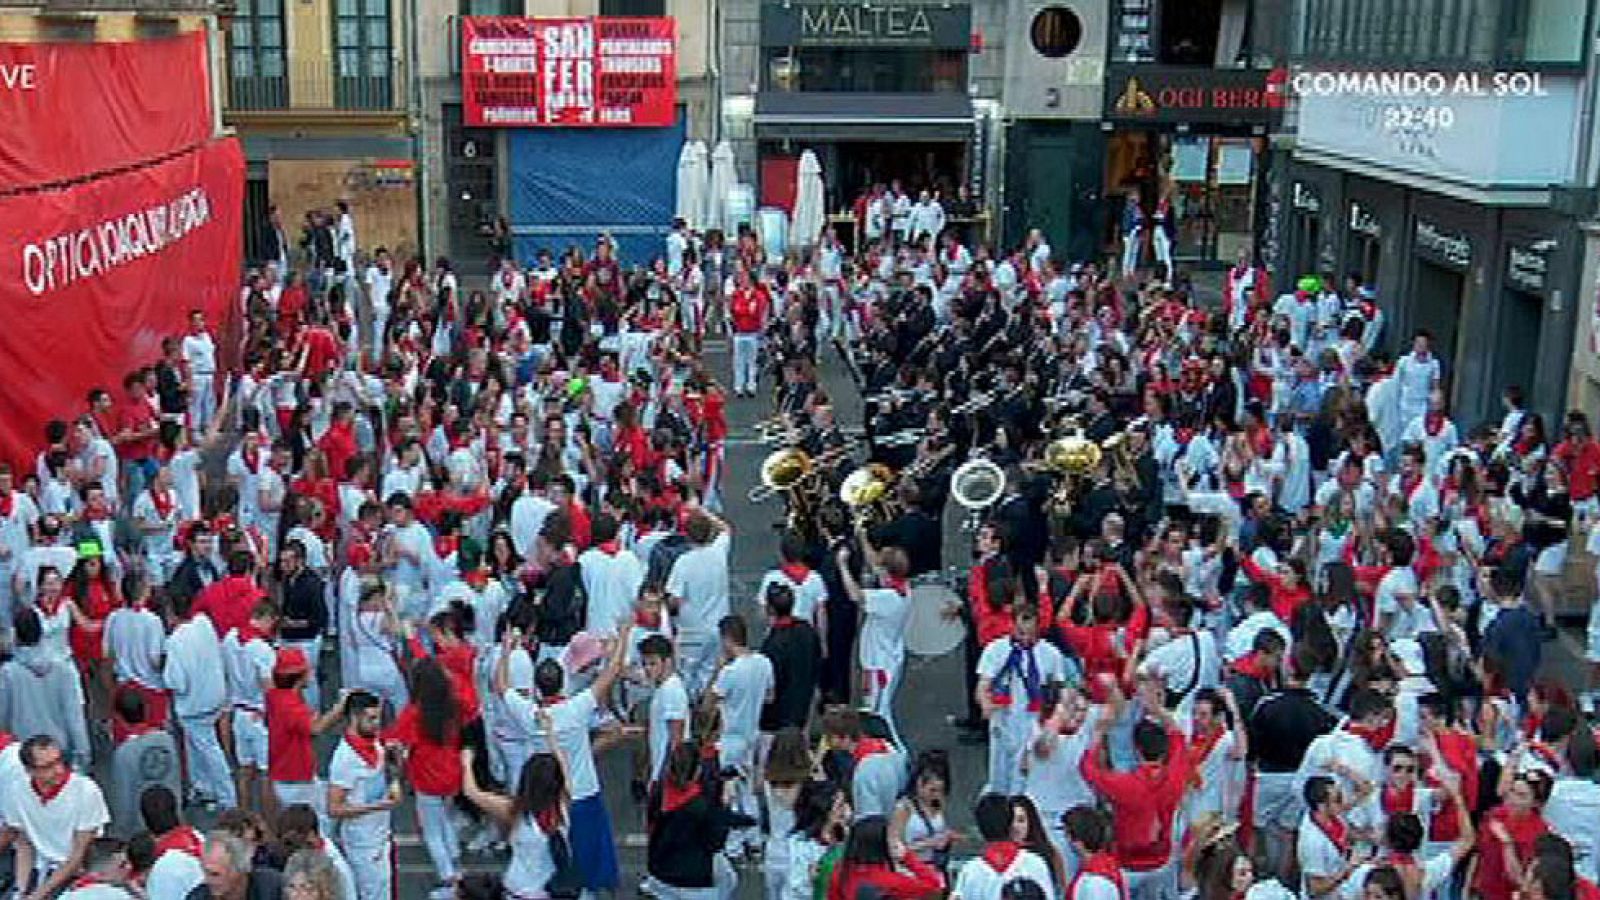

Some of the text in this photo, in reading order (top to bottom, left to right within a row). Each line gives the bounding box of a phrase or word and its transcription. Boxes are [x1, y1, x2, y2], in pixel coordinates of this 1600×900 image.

[801, 7, 931, 35] MALTEA
[544, 22, 593, 57] SAN
[544, 60, 593, 93] FER
[1159, 88, 1203, 108] OGI
